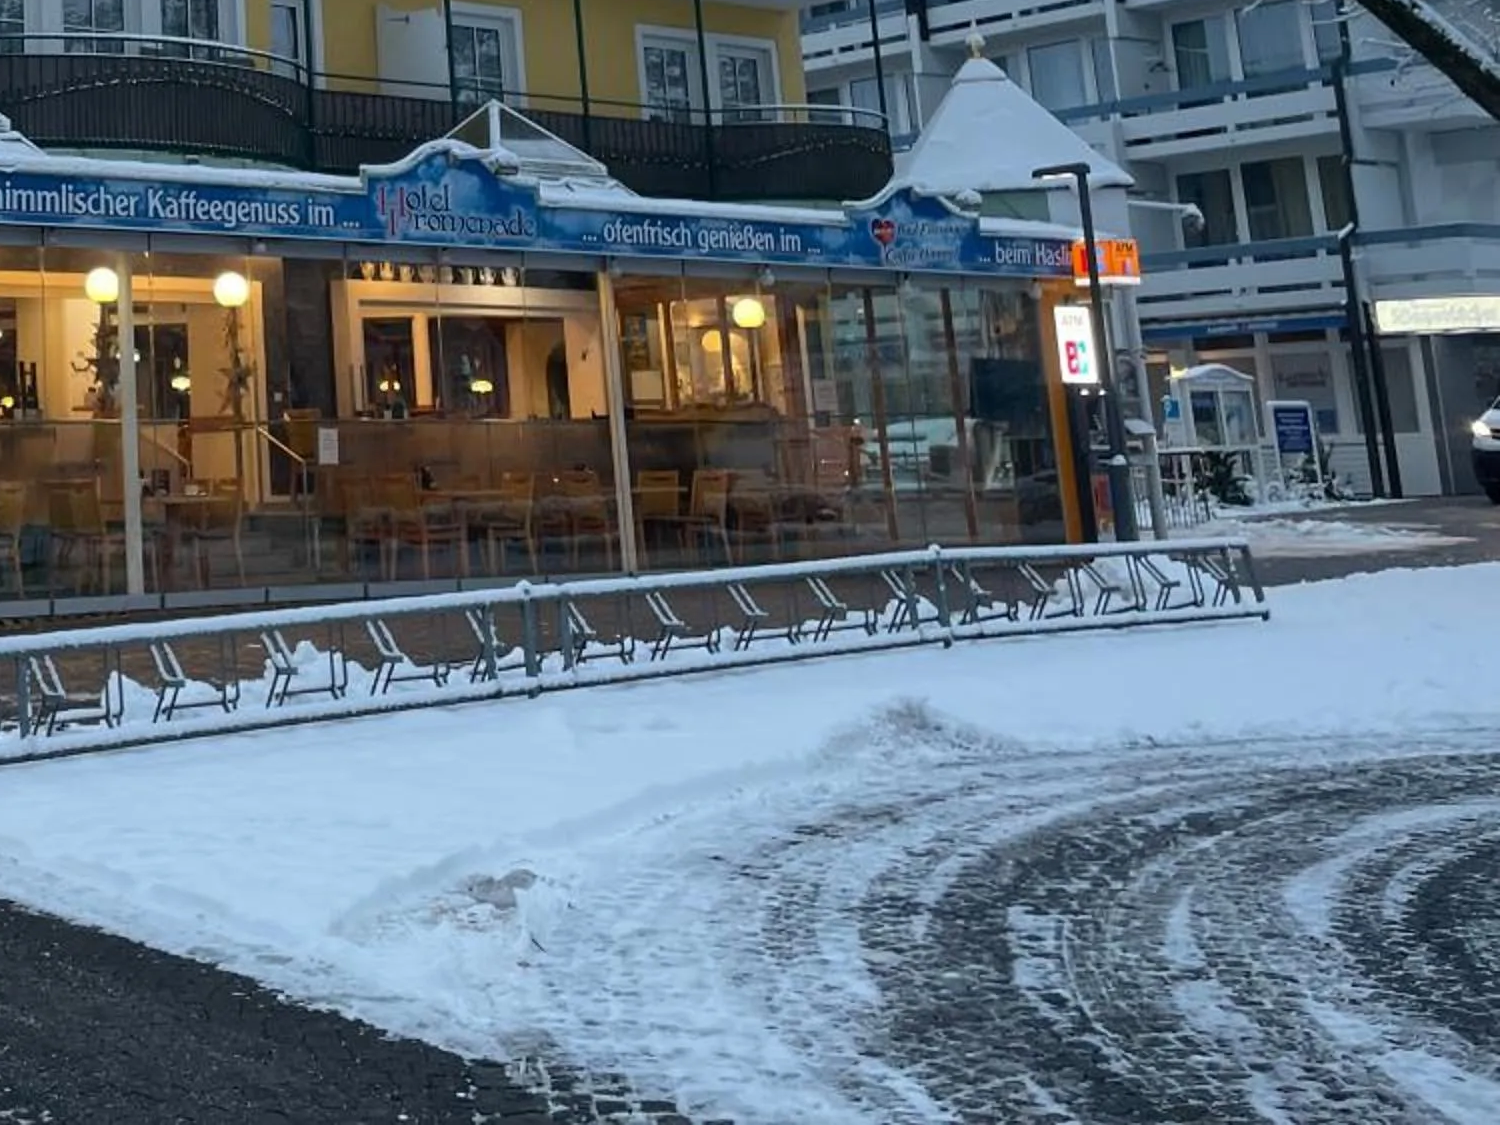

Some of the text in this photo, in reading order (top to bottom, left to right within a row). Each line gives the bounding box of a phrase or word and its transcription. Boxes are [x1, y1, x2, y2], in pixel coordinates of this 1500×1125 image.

[147, 188, 300, 228] Kaffeegenuss
[307, 198, 335, 227] im
[377, 184, 452, 217] Hotel
[389, 207, 535, 237] Promenade
[603, 218, 692, 247] ofenfrisch
[698, 224, 775, 253] genießen
[780, 227, 801, 252] im
[994, 240, 1031, 265] beim
